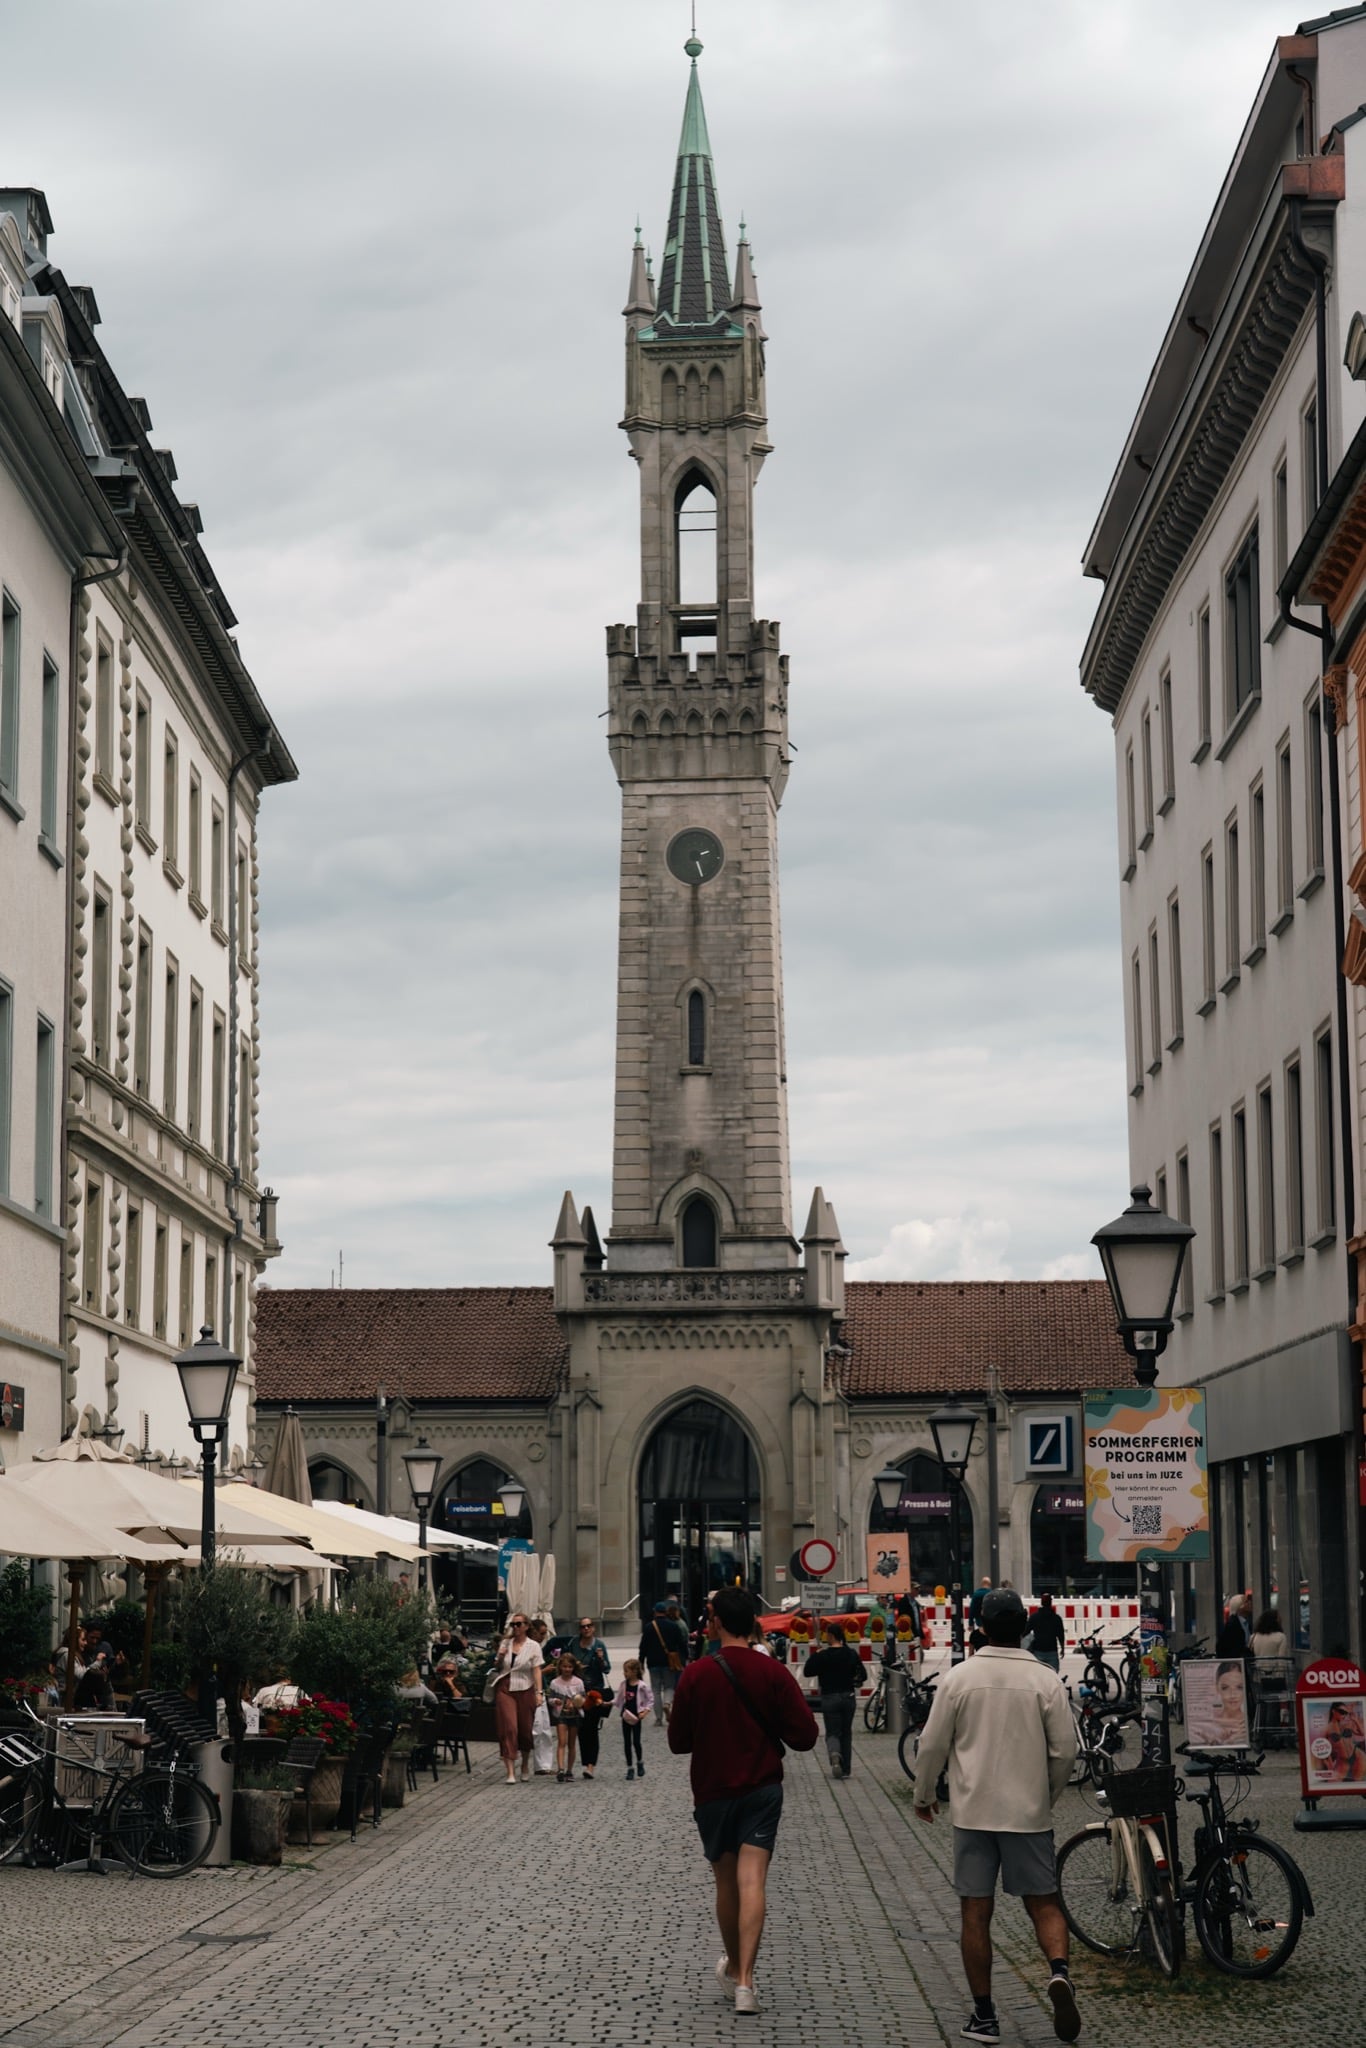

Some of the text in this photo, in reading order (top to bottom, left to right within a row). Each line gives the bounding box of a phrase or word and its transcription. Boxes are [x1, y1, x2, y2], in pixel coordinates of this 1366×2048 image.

[1088, 1436, 1203, 1448] SOMMERFERIEN
[1105, 1451, 1187, 1463] PROGRAMM
[1110, 1471, 1125, 1479] bei
[1146, 1471, 1158, 1479] im
[452, 1504, 487, 1513] reisebank
[904, 1500, 929, 1508] Presse
[929, 1500, 935, 1508] &
[1305, 1669, 1361, 1688] ORION
